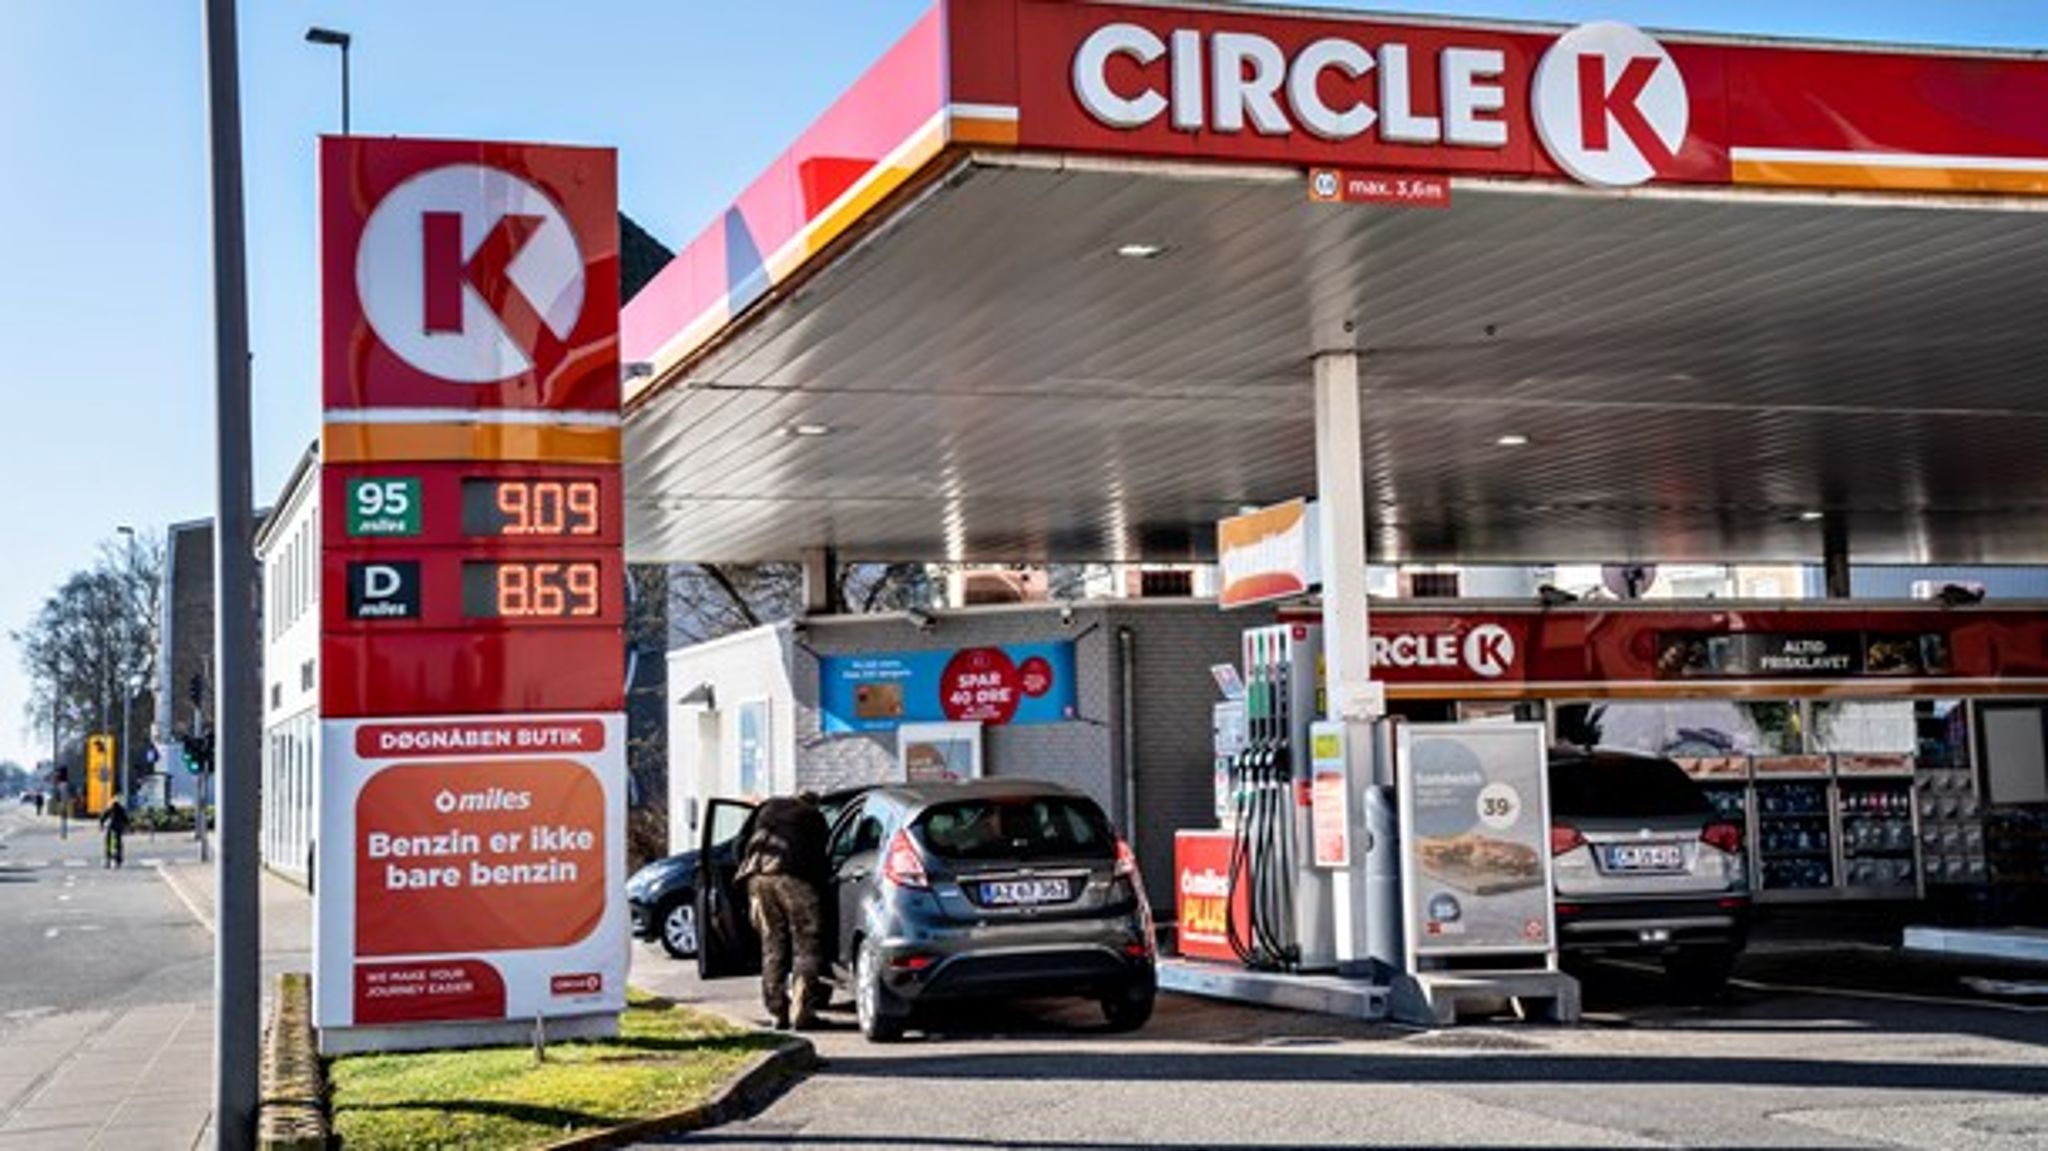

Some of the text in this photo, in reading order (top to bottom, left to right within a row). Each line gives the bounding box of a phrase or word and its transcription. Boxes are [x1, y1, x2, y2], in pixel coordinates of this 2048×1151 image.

[1074, 22, 1508, 146] CIRCLE
[1348, 180, 1394, 195] max.
[421, 210, 566, 368] K
[358, 482, 409, 515] 95
[497, 482, 599, 534] 9.09
[359, 519, 406, 532] miles
[364, 565, 402, 599] D
[498, 563, 599, 616] 8.69
[359, 601, 407, 615] miles
[958, 672, 1002, 688] SPAR
[379, 728, 583, 750] DØGNÅBEN BUTIK
[458, 787, 532, 812] miles
[368, 826, 594, 858] Benzin er ikke
[386, 858, 578, 890] bare benzin
